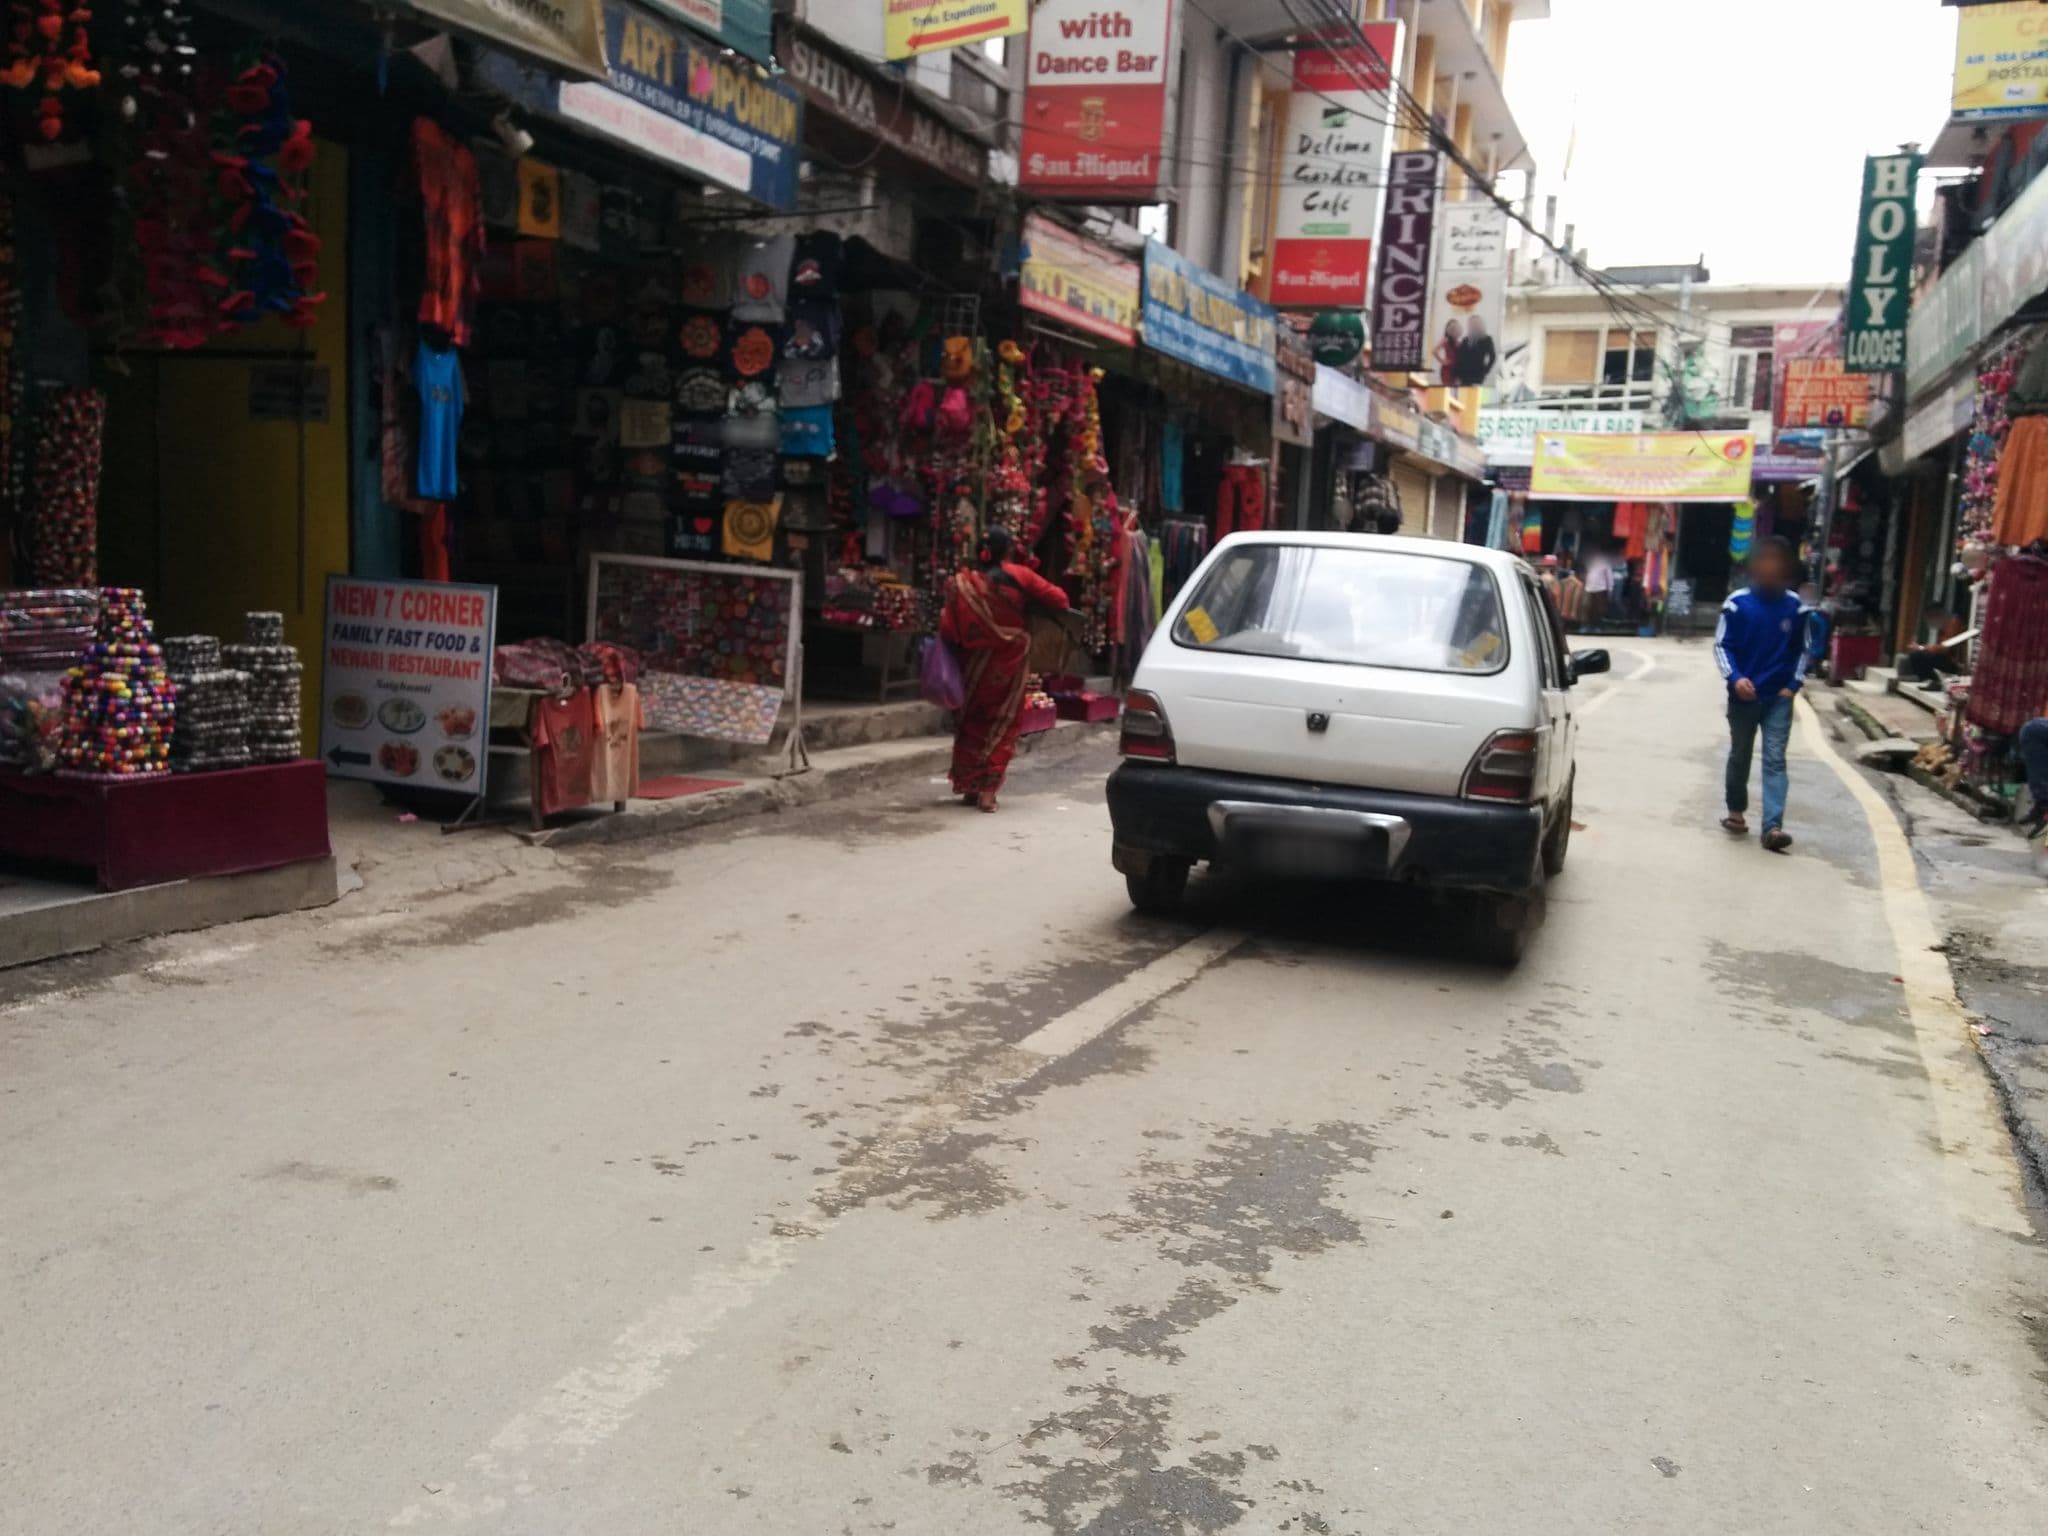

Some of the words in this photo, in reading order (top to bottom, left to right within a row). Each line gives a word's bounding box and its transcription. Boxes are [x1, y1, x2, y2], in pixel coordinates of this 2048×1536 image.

[1059, 11, 1133, 39] with
[620, 16, 679, 88] ART
[1036, 52, 1109, 75] Dance
[1116, 50, 1158, 73] Bar
[791, 38, 877, 130] SHIVA
[1027, 152, 1071, 177] San
[1072, 151, 1151, 181] Miguel
[1379, 153, 1436, 332] PRINCE
[1862, 157, 1912, 326] HOLY
[1277, 269, 1307, 286] San
[1308, 270, 1361, 289] Miguel
[1376, 332, 1421, 349] GUEST
[1848, 329, 1903, 365] LODGE
[333, 584, 377, 617] NEW
[383, 588, 395, 619] 7
[401, 591, 485, 627] CORNER
[332, 622, 384, 644] FAMILY
[386, 628, 422, 649] FAST
[425, 632, 467, 651] FOOD
[470, 635, 481, 653] &
[331, 647, 384, 671] NEWARI
[388, 653, 481, 680] RESTAURANT
